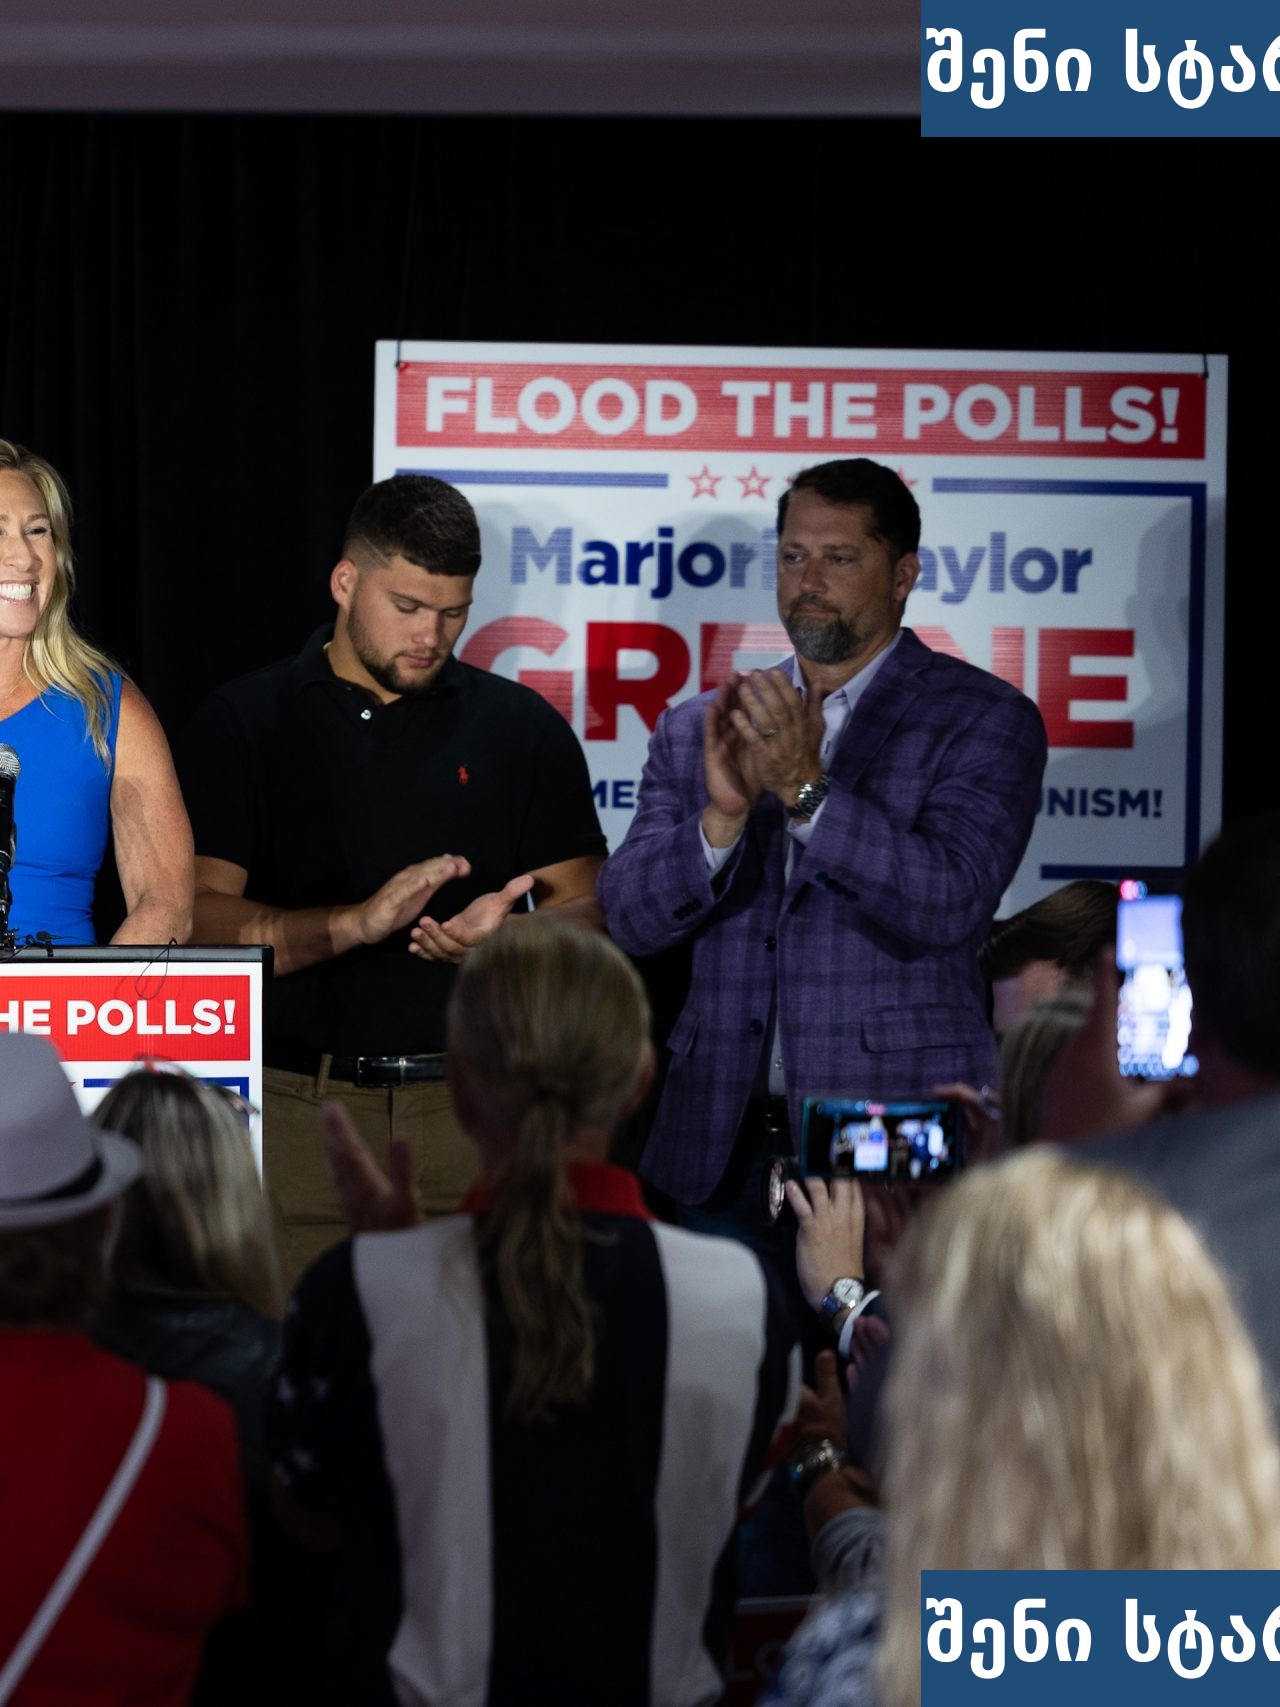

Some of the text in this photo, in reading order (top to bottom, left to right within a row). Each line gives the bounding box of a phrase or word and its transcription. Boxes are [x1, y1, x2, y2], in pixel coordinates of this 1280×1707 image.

[425, 376, 1179, 442] FLOOD THE POLLS!
[510, 525, 1093, 605] Marjori aylor
[66, 998, 237, 1036] POLLS!
